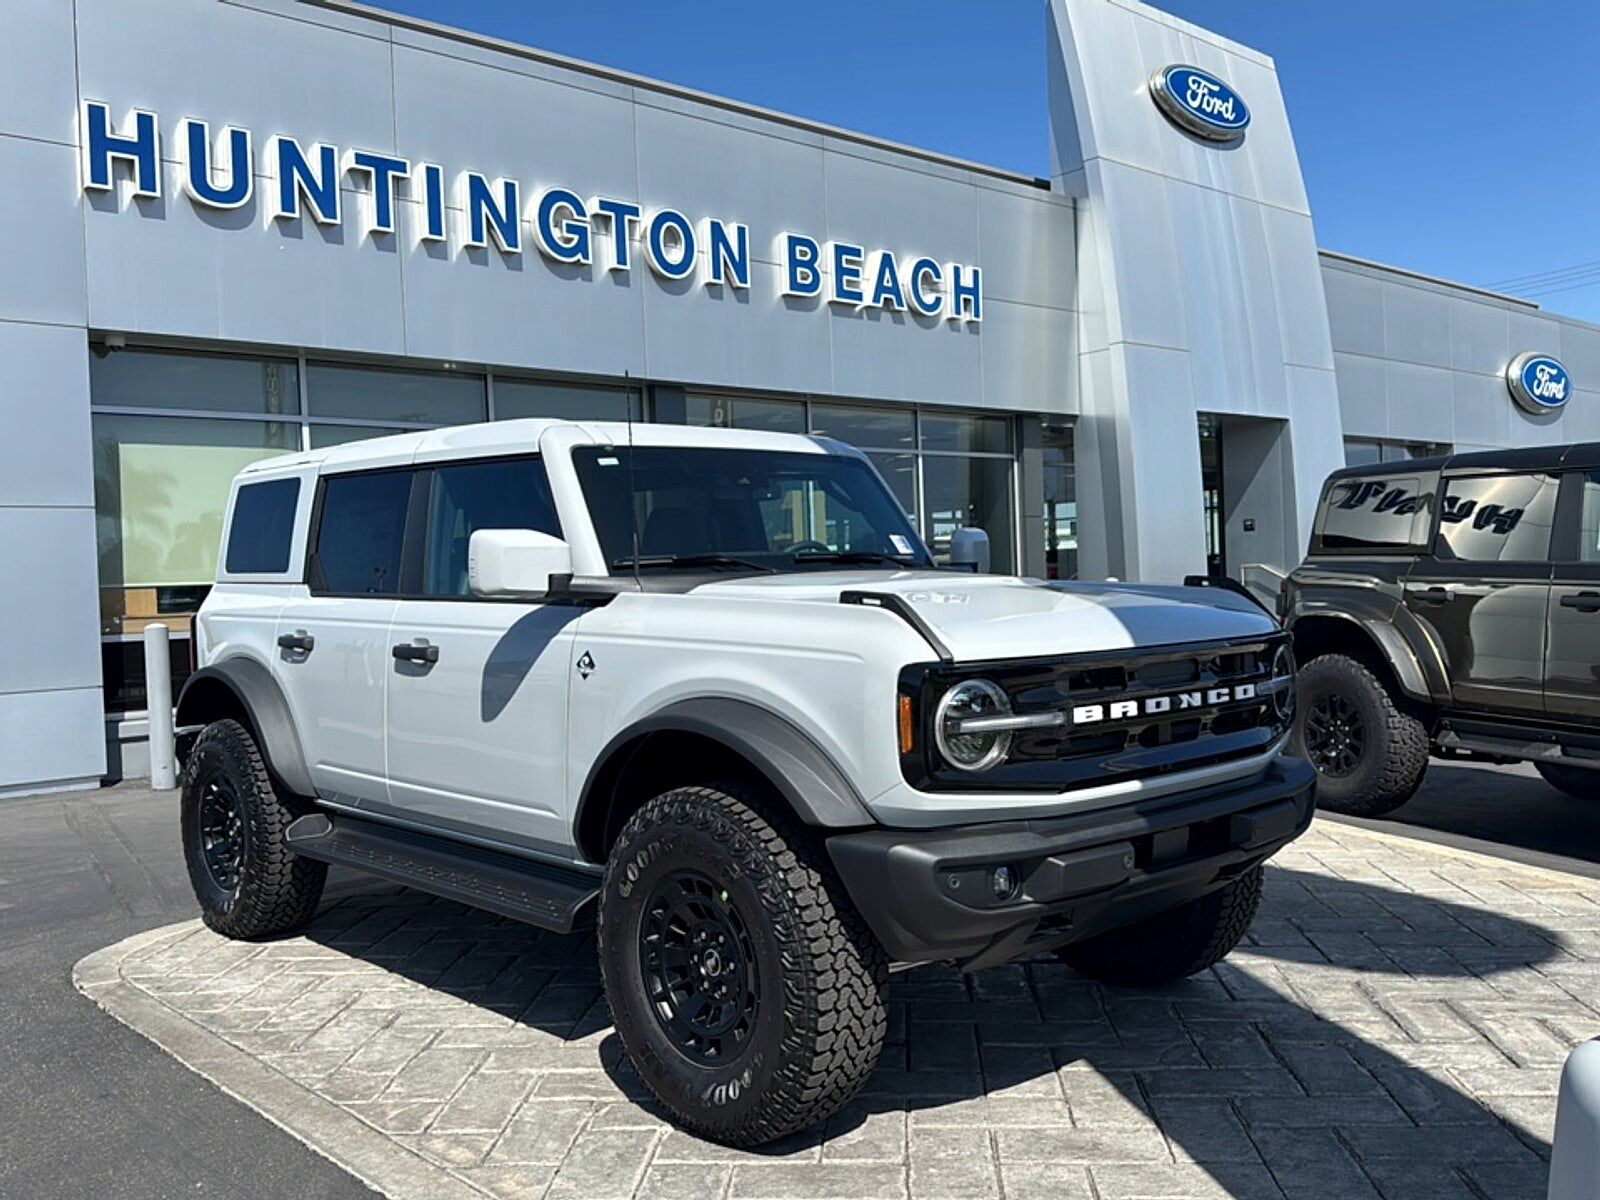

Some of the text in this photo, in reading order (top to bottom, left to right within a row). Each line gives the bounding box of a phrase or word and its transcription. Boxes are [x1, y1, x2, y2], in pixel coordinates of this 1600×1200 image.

[1186, 75, 1237, 121] Ford
[84, 100, 983, 322] HUNTINGTON BEACH
[1533, 364, 1566, 400] Ford
[1072, 683, 1256, 725] BRONCO
